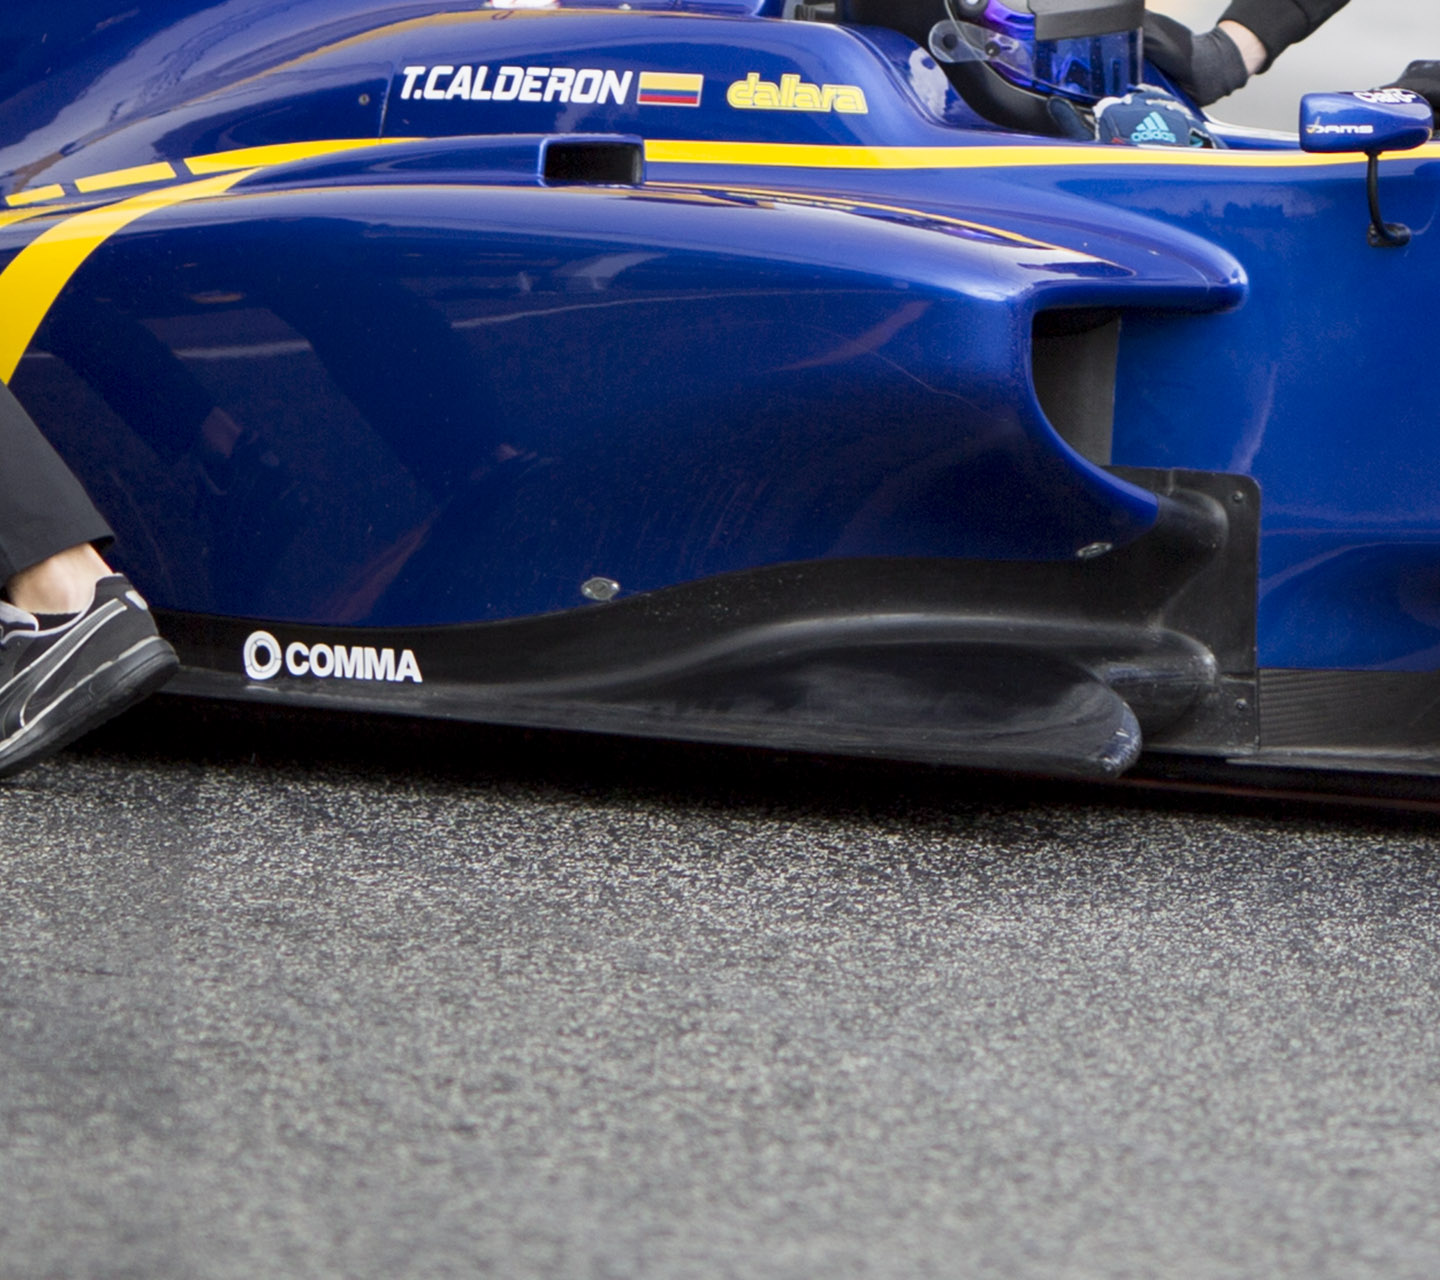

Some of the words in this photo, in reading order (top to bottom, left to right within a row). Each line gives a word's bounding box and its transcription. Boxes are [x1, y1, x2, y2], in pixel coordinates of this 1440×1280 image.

[400, 64, 634, 107] T.CALDERON
[726, 72, 869, 115] dallara
[1130, 129, 1177, 144] adidas
[285, 640, 423, 684] COMMA
